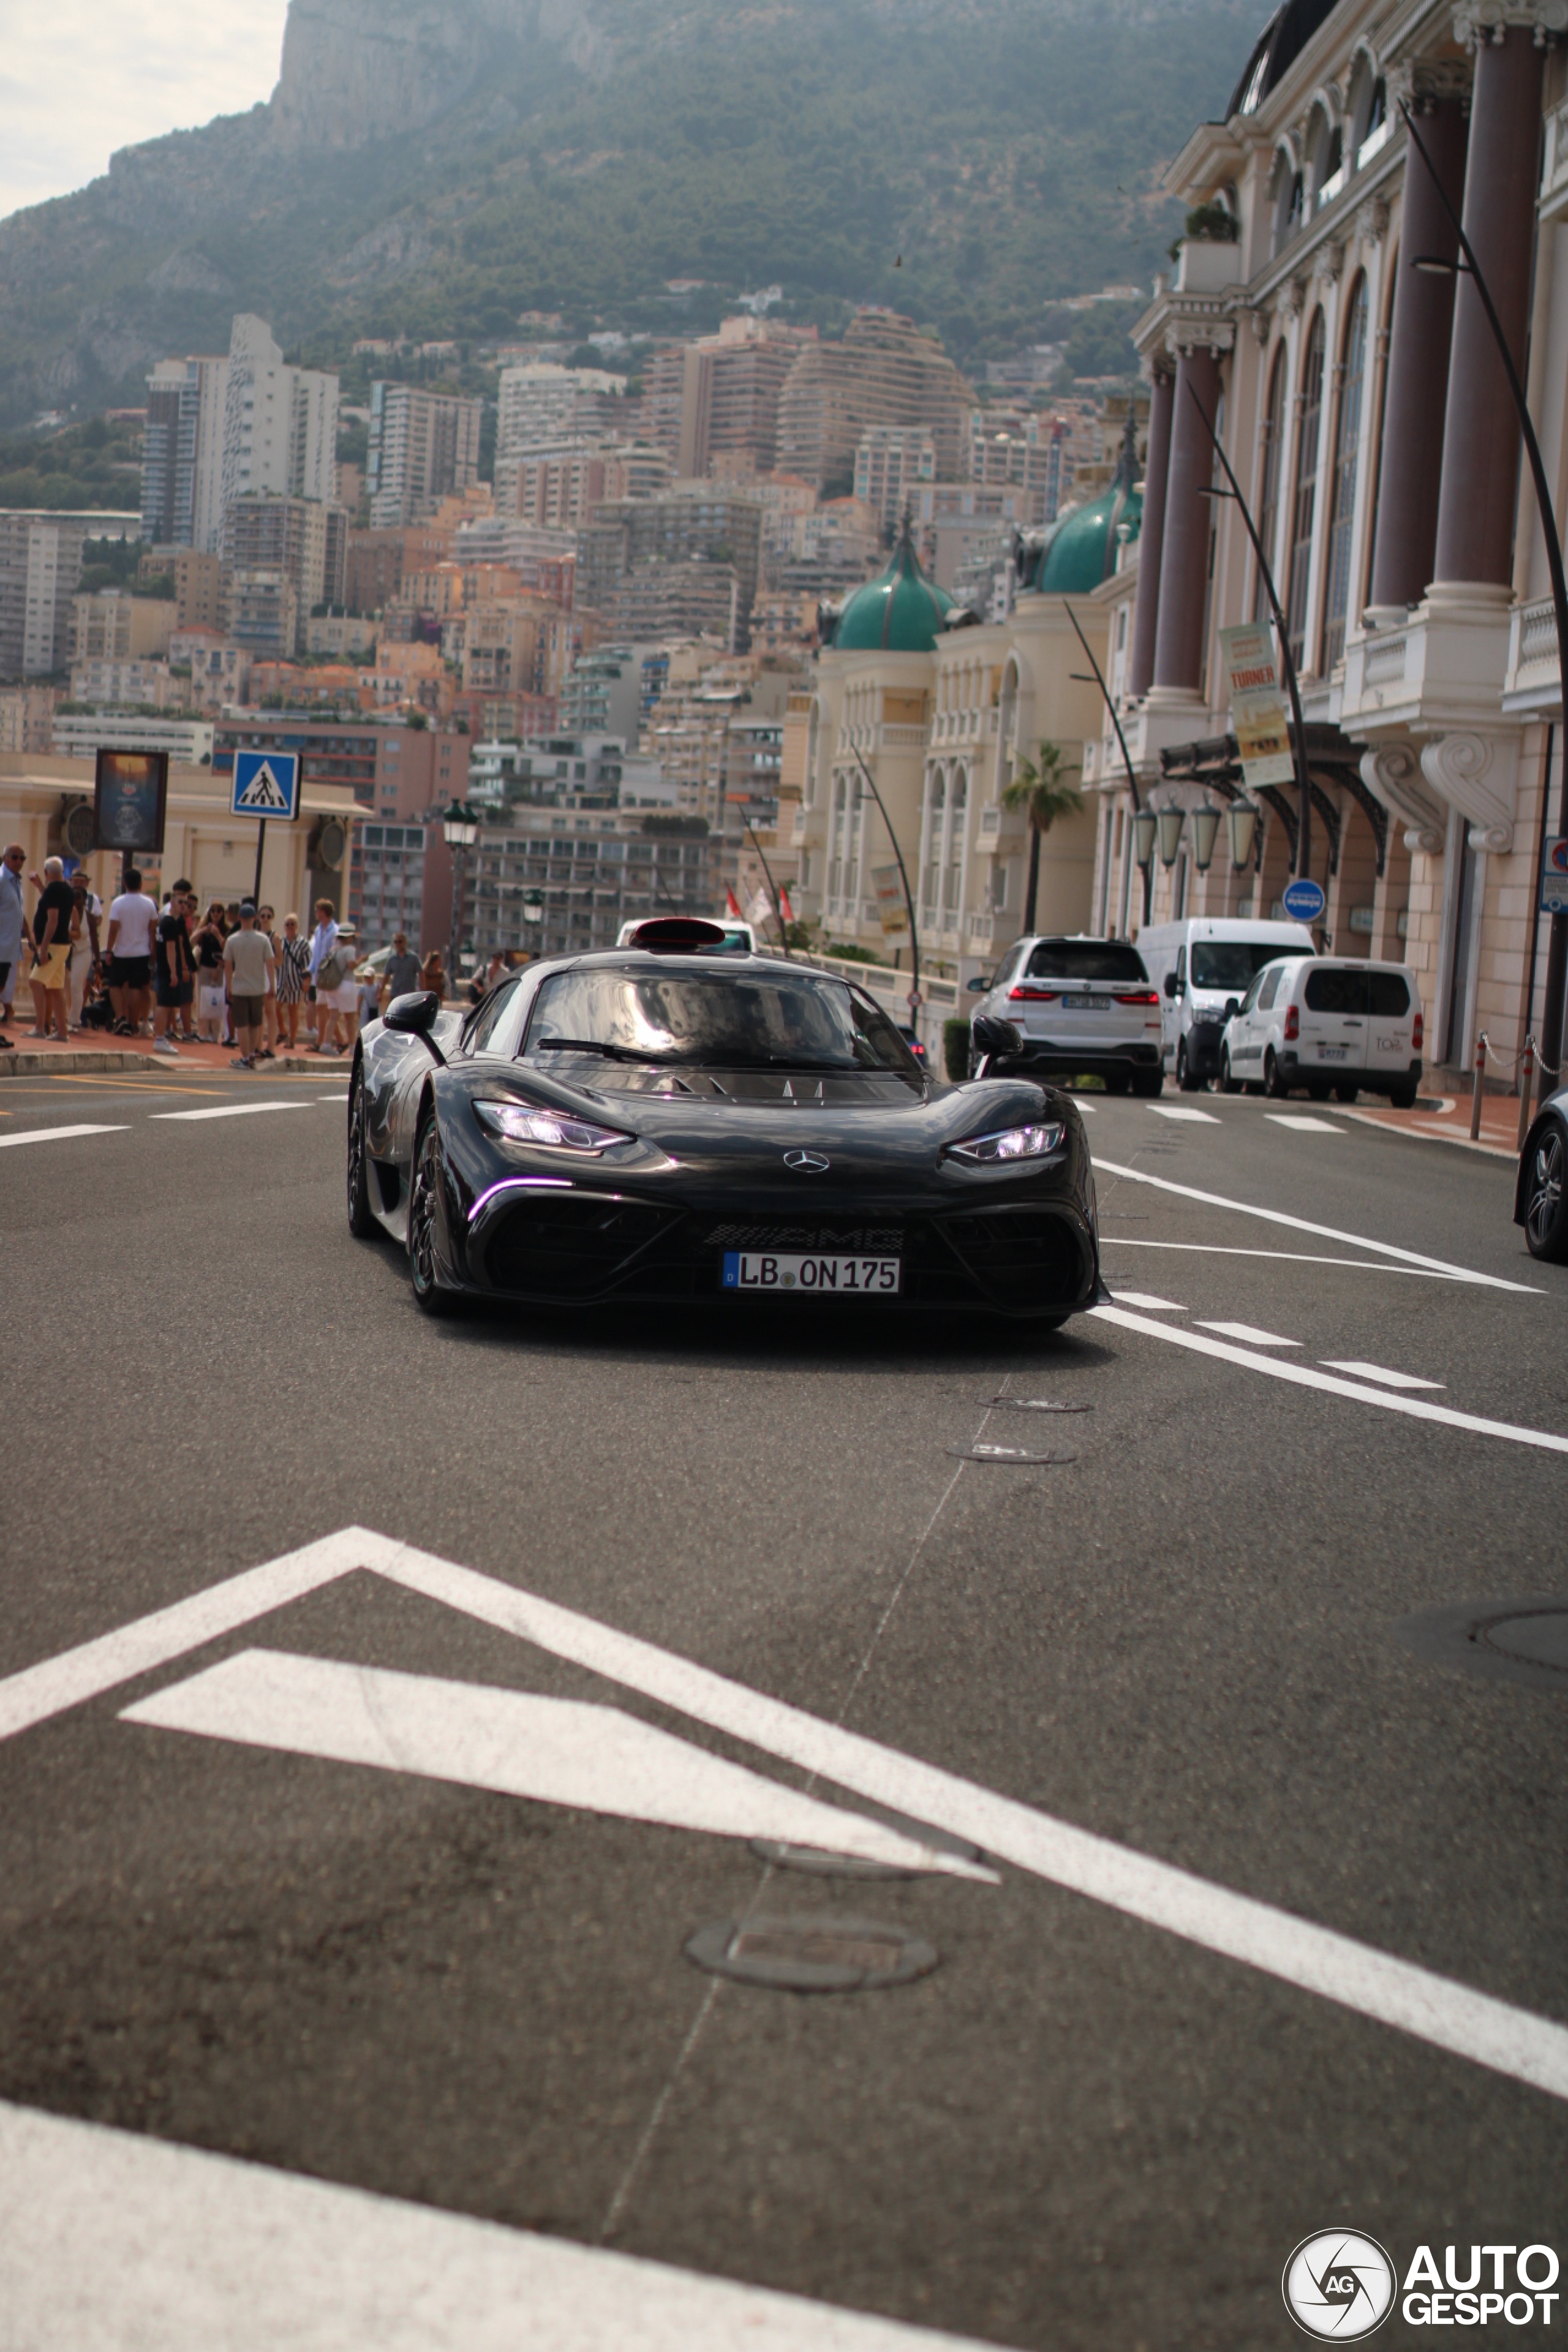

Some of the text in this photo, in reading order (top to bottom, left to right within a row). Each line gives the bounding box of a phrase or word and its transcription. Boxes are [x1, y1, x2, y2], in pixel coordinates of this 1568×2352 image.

[1231, 665, 1275, 690] TURNER
[741, 1257, 778, 1285] LB
[843, 1261, 896, 1289] 175
